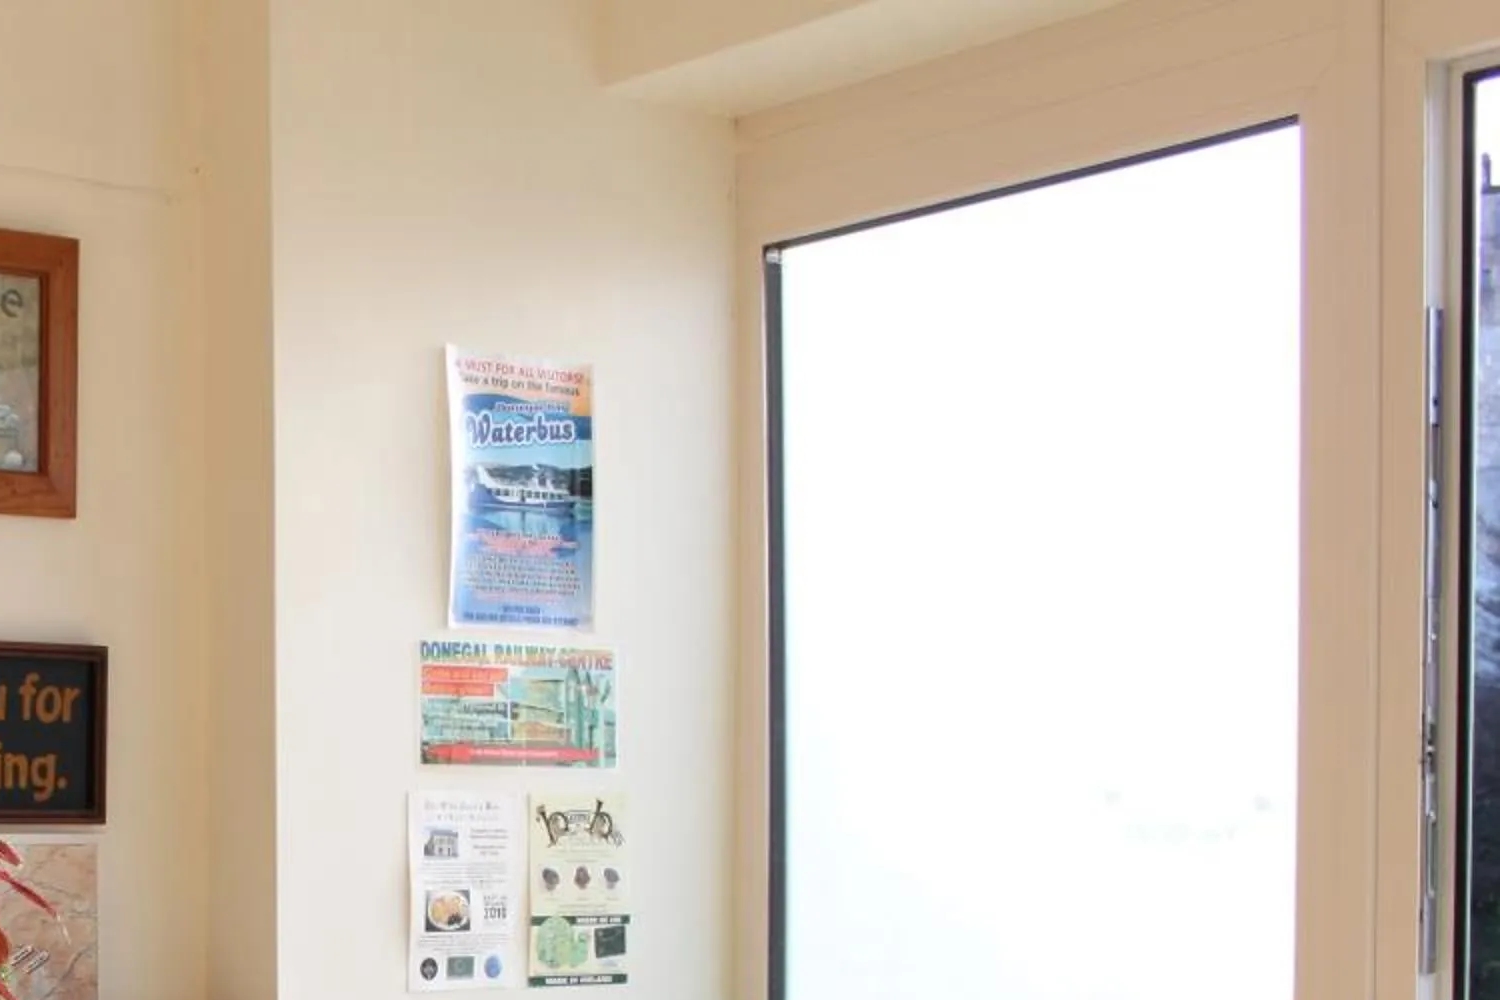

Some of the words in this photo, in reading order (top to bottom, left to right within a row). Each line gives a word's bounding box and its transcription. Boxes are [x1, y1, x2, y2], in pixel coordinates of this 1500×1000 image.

[495, 362, 515, 375] FOR
[491, 375, 509, 389] trip
[511, 379, 525, 389] on
[466, 412, 574, 446] Waterbus
[420, 640, 488, 659] DONEGAL
[19, 672, 82, 724] for
